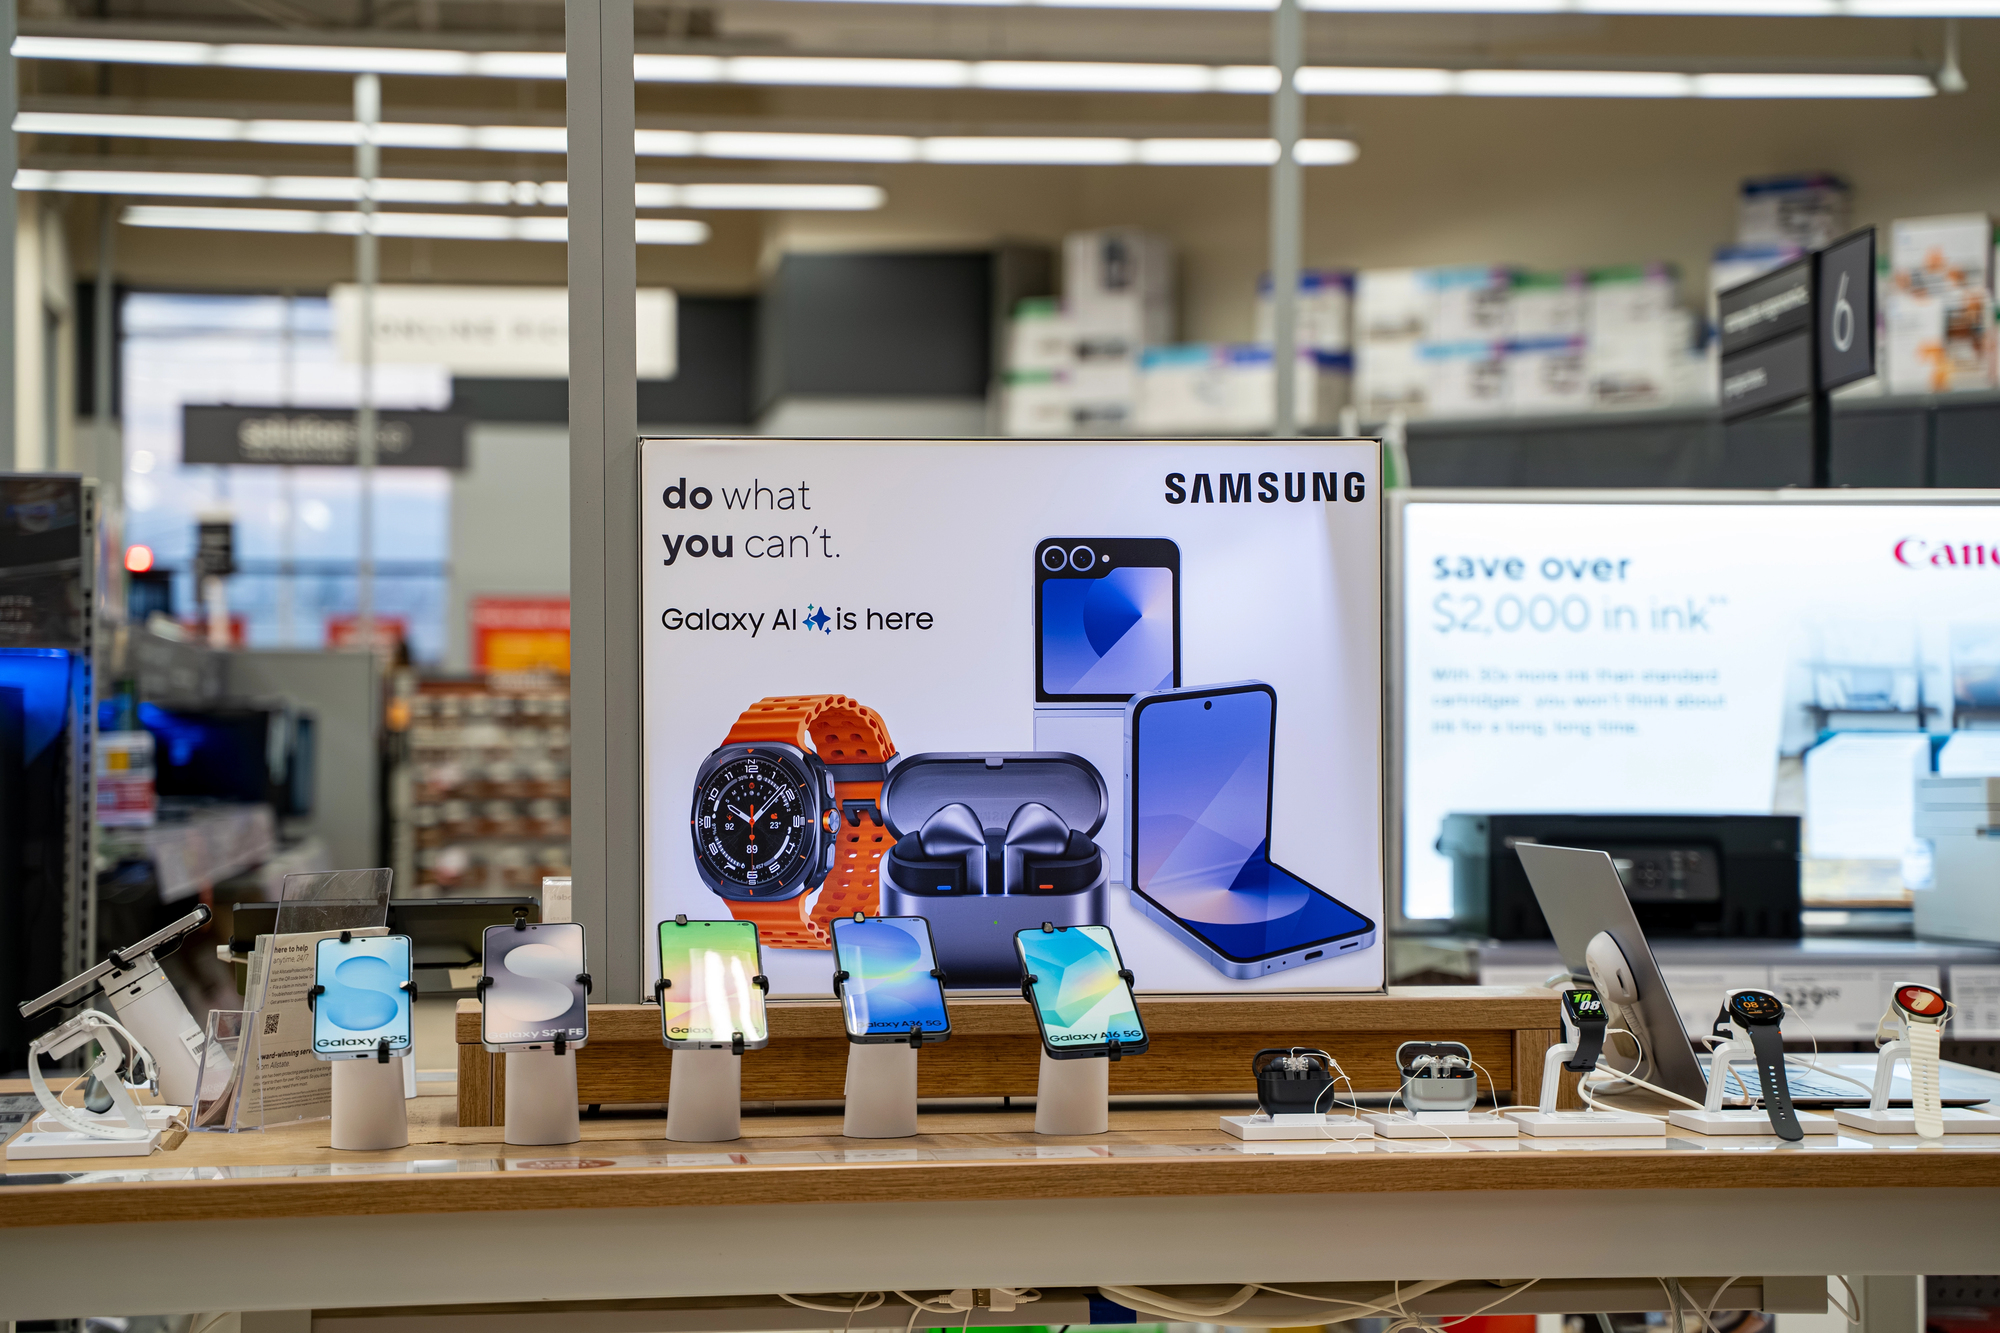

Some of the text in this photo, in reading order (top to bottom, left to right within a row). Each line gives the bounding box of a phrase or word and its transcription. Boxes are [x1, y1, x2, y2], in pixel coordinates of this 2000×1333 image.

[1833, 270, 1855, 352] 6
[1164, 471, 1366, 505] SAMSUNG
[662, 477, 811, 510] do what
[661, 525, 840, 566] you can't.
[1433, 555, 1632, 582] save over
[1432, 591, 1592, 634] $2,000
[1603, 594, 1638, 632] in
[661, 606, 934, 638] Galaxy AI is here
[745, 764, 758, 773] 12
[725, 771, 734, 781] 11
[708, 788, 719, 801] 10
[746, 845, 758, 854] 89
[296, 944, 308, 953] help
[1573, 993, 1592, 1003] 10
[1580, 1001, 1601, 1010] 08
[488, 1031, 539, 1039] Galaxy
[1049, 1033, 1097, 1042] Galaxy
[317, 1038, 377, 1047] Galaxy
